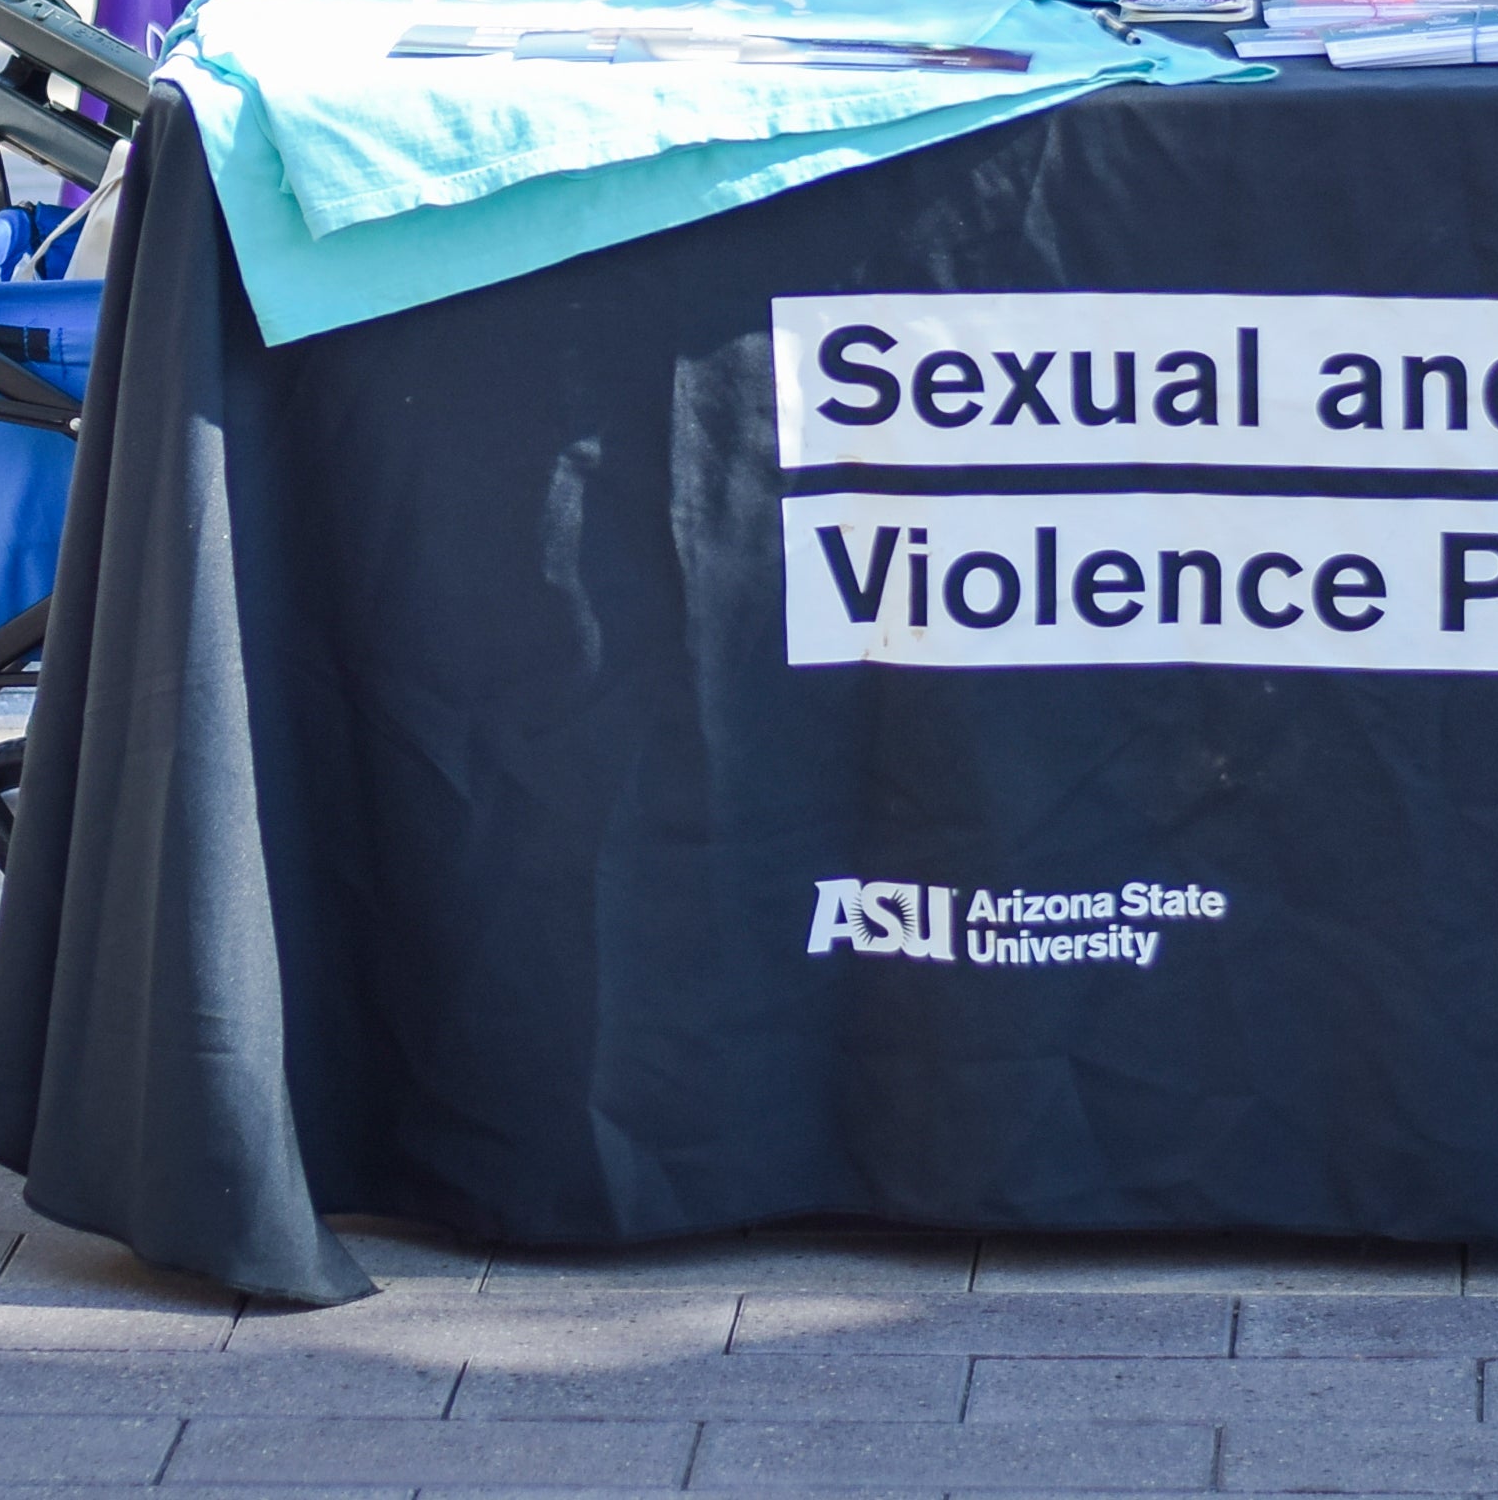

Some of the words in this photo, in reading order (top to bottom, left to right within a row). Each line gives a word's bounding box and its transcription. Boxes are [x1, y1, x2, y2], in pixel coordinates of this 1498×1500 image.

[816, 324, 1260, 428] Sexual
[815, 525, 1387, 632] Violence
[807, 878, 956, 960] ASU
[966, 888, 1115, 922] Arizona
[1120, 881, 1226, 918] State
[966, 923, 1159, 965] University
